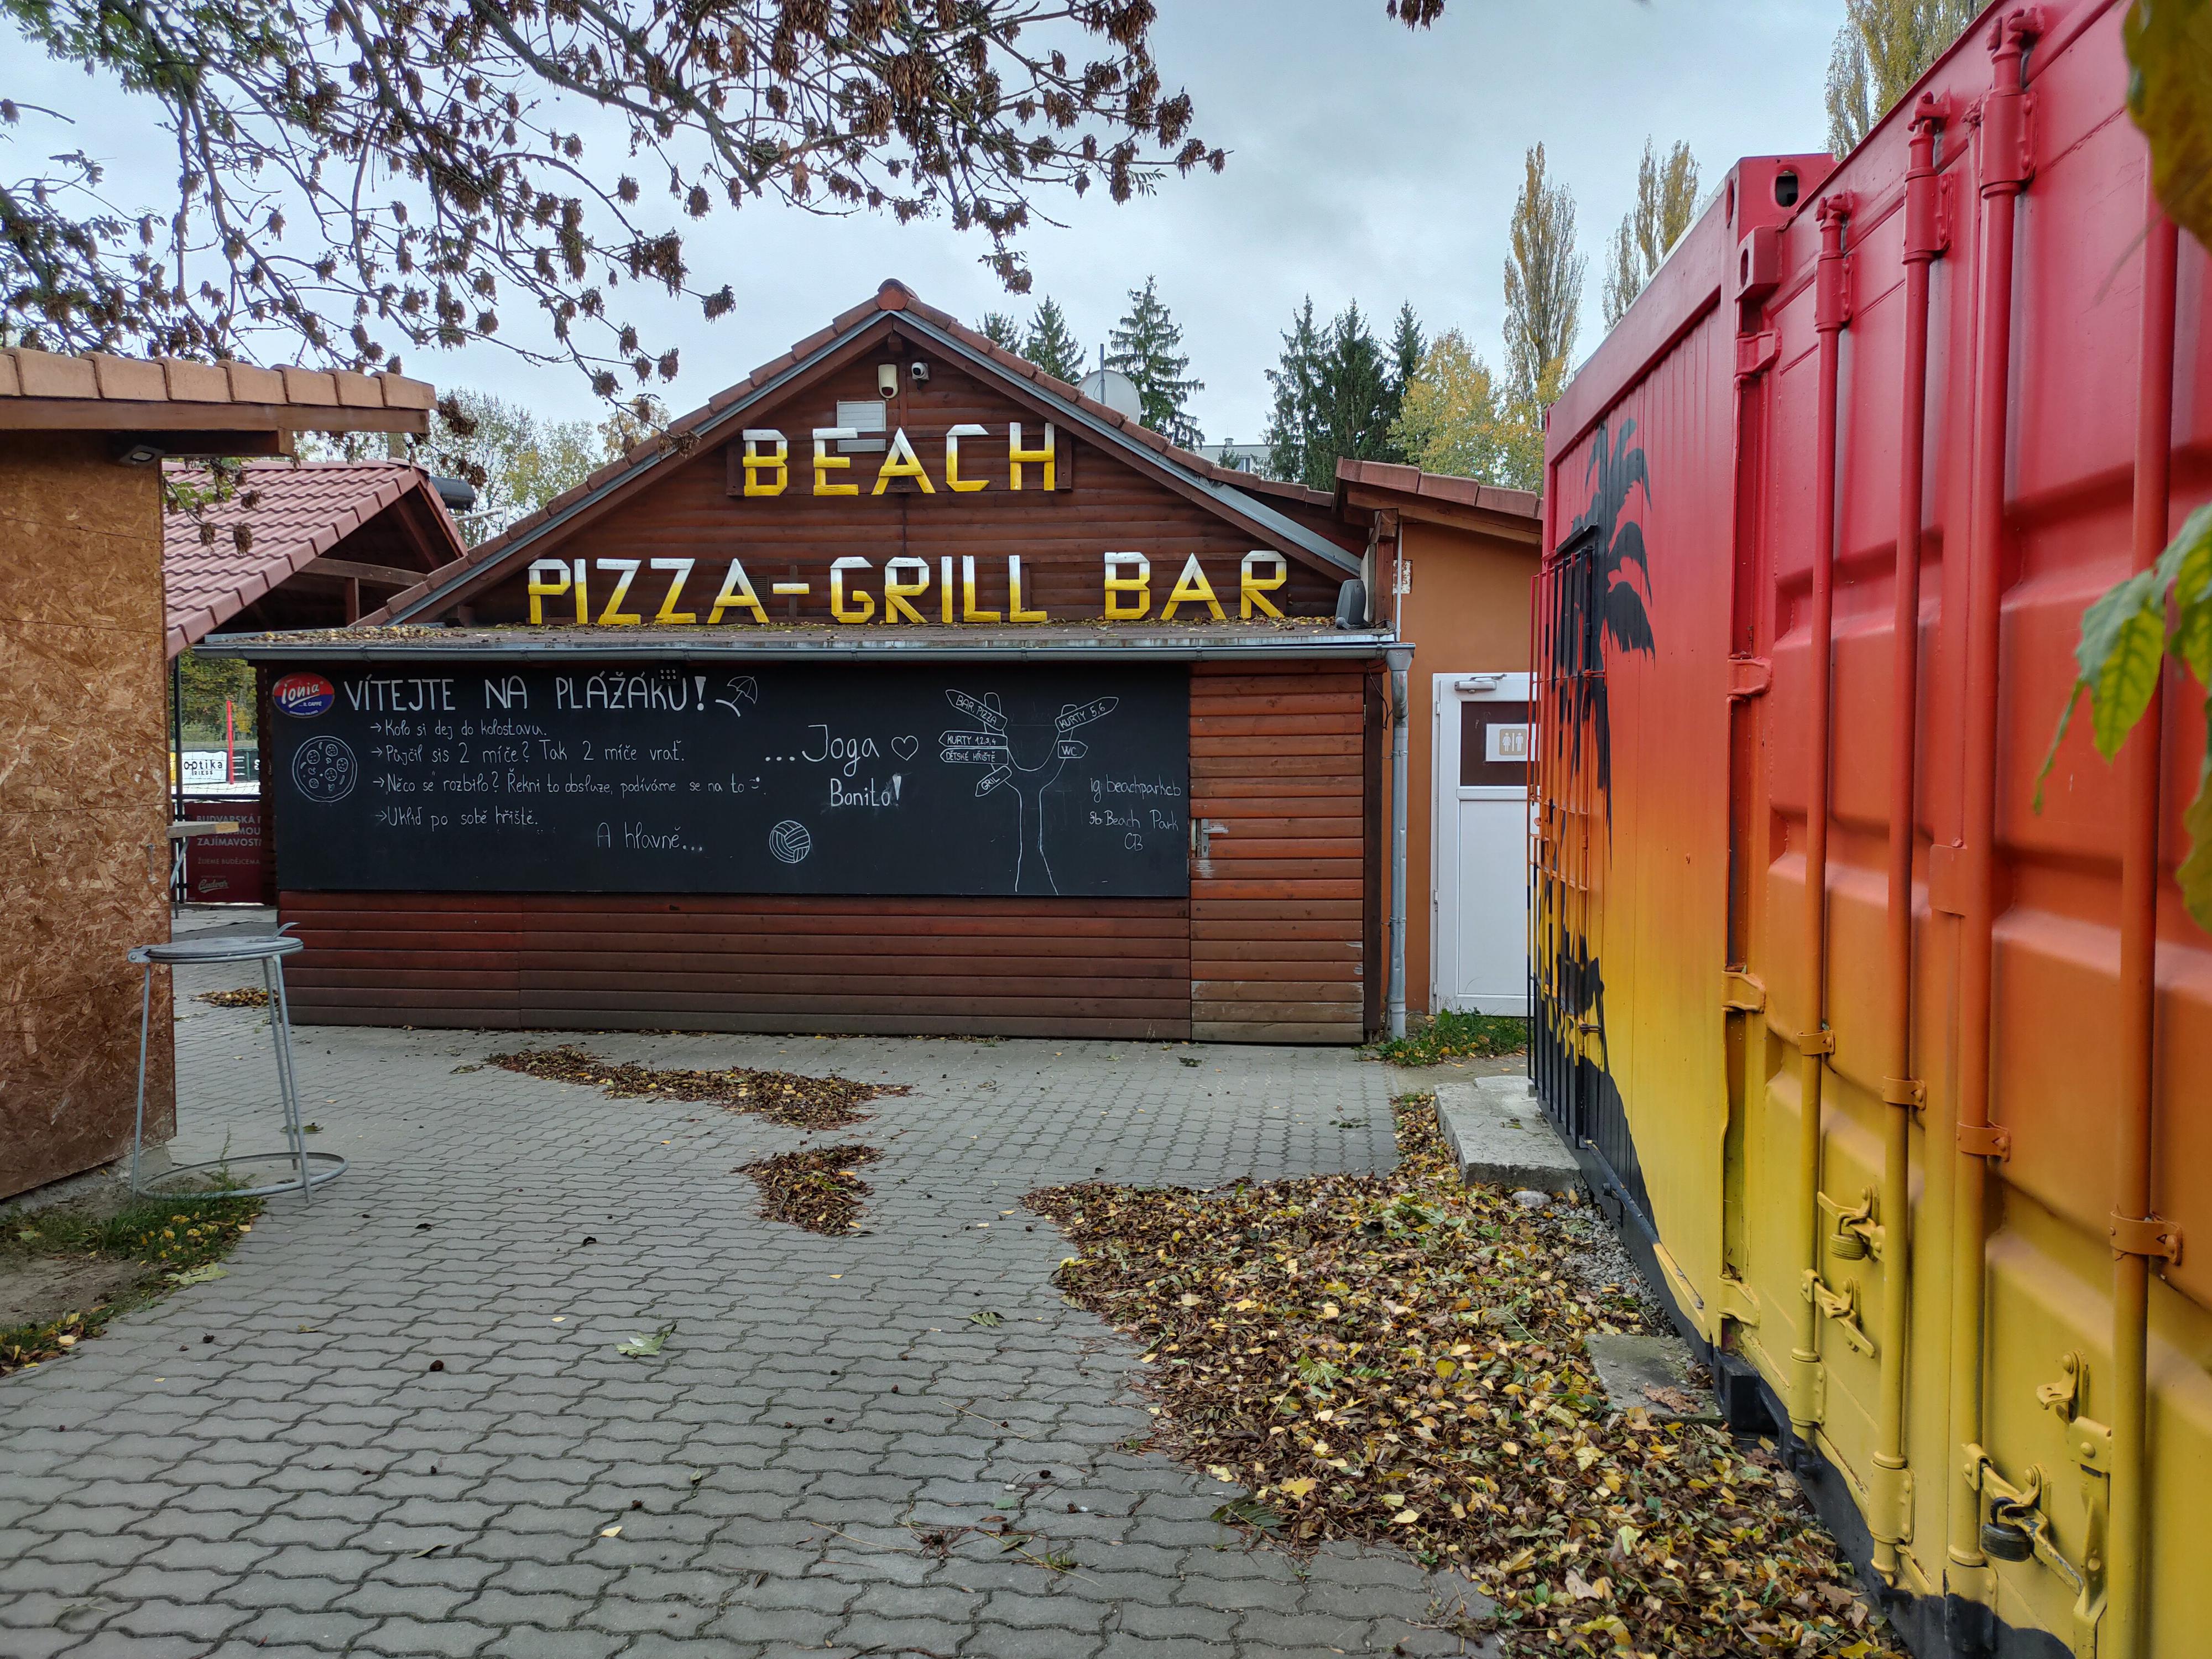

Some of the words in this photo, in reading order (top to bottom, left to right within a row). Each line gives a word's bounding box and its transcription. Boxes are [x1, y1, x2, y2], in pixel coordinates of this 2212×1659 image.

[742, 421, 1055, 496] BEACH
[1104, 550, 1287, 620] BAR
[281, 682, 319, 705] ionia
[344, 674, 456, 711] VÍTEJTE
[485, 675, 528, 709] NA
[556, 671, 706, 712] PLÁŽÁKU!
[976, 706, 997, 726] PIZZA
[1058, 711, 1086, 729] KURTY
[1090, 702, 1105, 717] 5,6
[385, 719, 410, 735] Kolo
[418, 723, 427, 735] si
[435, 719, 452, 740] dej
[461, 719, 474, 736] do
[481, 718, 547, 736] kolostavu.
[947, 734, 972, 745] KURTY
[386, 744, 422, 765] Půjčil
[432, 748, 450, 762] sis
[458, 742, 469, 763] 2
[539, 739, 567, 760] Tak
[583, 740, 594, 760] 2
[604, 744, 638, 761] míče
[650, 739, 685, 761] vrať.
[1062, 745, 1078, 757] WC
[183, 760, 223, 775] optika
[508, 768, 540, 792] Řekni
[547, 773, 560, 792] to
[565, 773, 613, 795] obsluze,
[620, 775, 676, 799] podíváme
[690, 781, 701, 792] se
[708, 782, 723, 792] na
[730, 773, 745, 793] to
[981, 776, 1000, 790] GRIL
[430, 816, 448, 832] po
[461, 807, 487, 825] sobě
[1149, 809, 1179, 831] Park
[597, 822, 611, 849] A
[1124, 833, 1143, 851] CB
